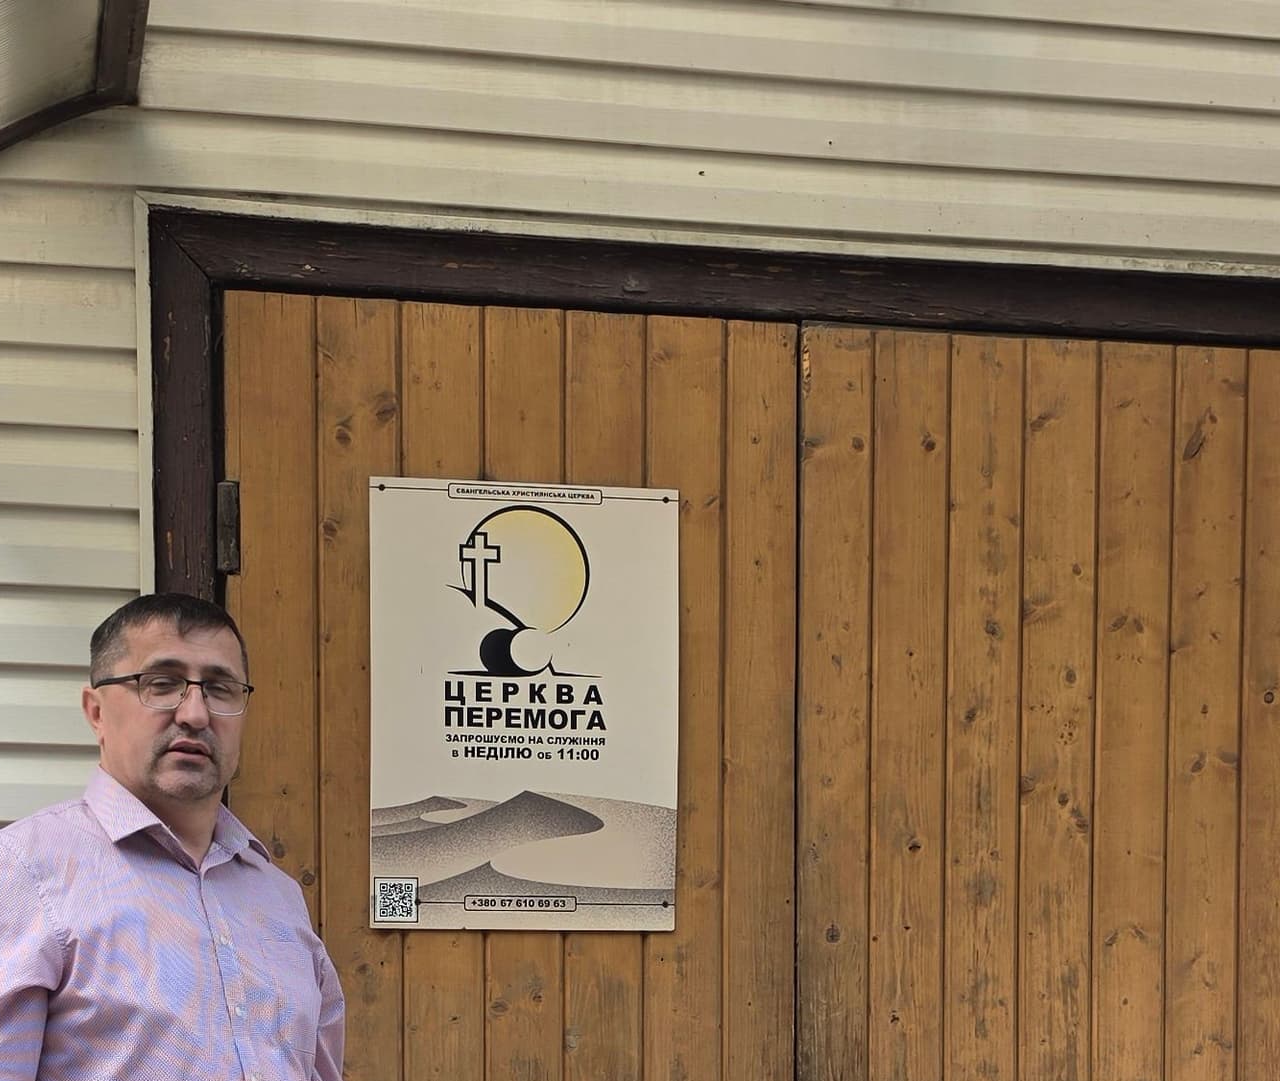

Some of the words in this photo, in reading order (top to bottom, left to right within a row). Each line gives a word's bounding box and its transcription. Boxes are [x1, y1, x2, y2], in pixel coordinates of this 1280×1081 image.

[444, 681, 604, 706] ЦЕРКВА
[444, 706, 607, 731] ПЕРЕМОГА
[445, 734, 525, 745] ЗАПРОШУЄМО
[528, 736, 544, 745] НА
[547, 737, 606, 746] СЛУЖІННЯ
[464, 746, 532, 760] НЕДІЛЮ
[558, 748, 600, 761] 11:00
[471, 899, 496, 907] +380
